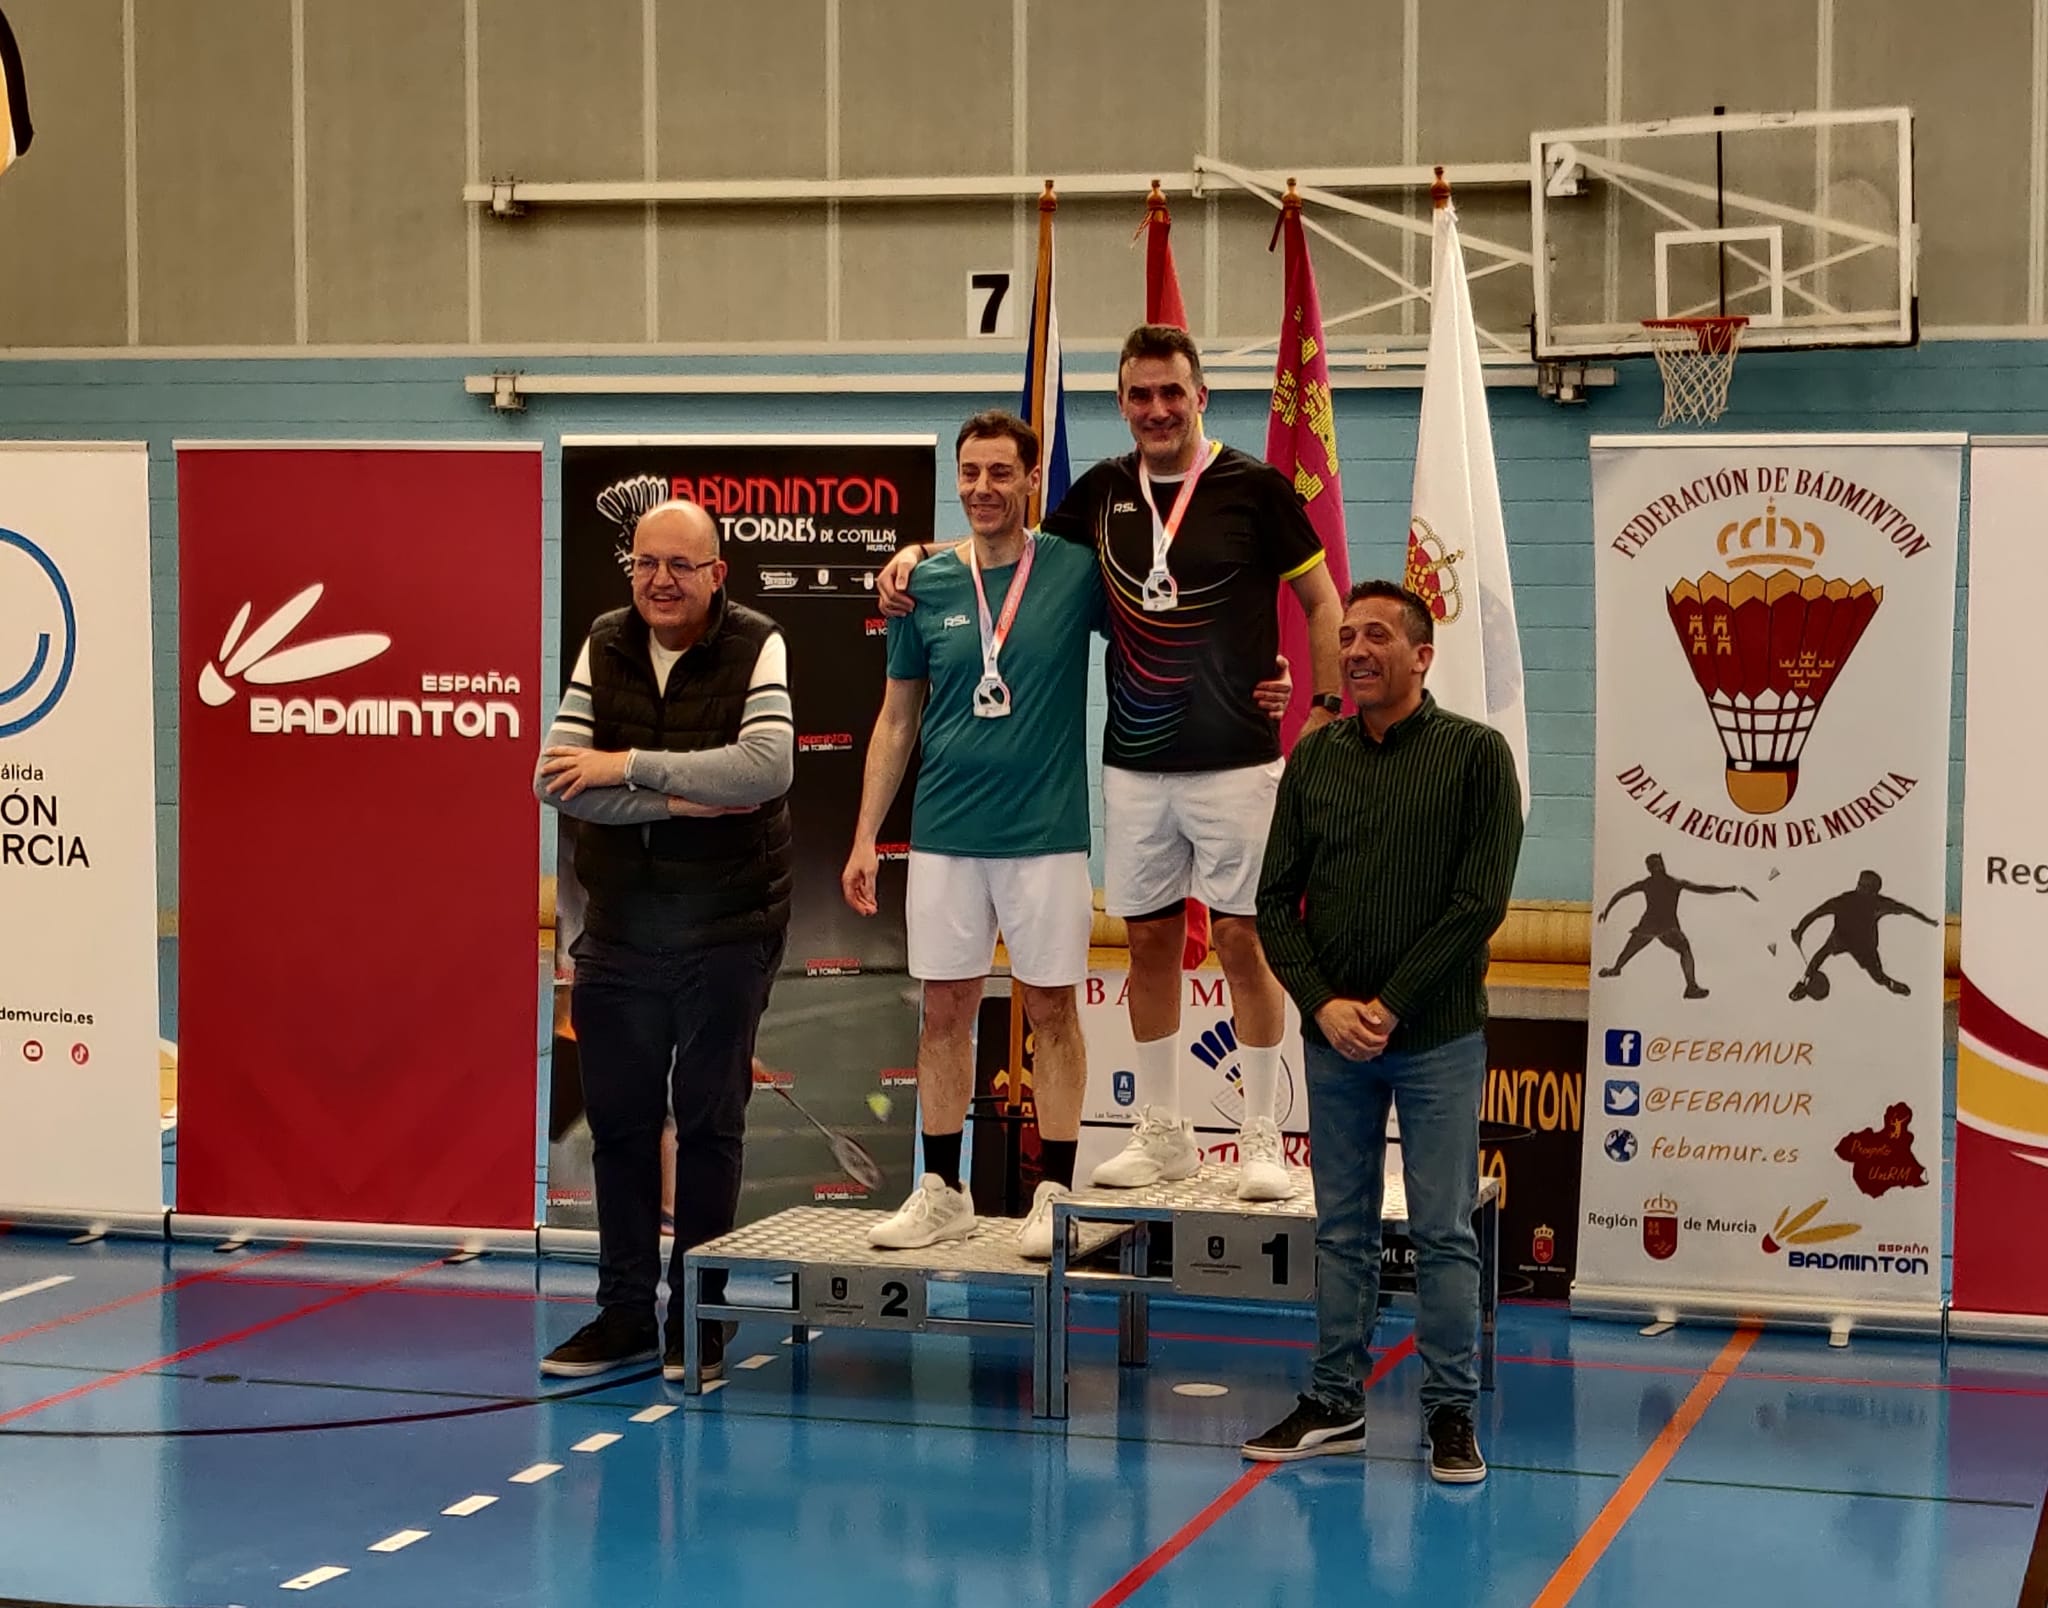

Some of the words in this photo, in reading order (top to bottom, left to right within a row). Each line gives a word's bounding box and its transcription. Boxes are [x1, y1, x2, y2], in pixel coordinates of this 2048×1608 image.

[1546, 142, 1579, 197] 2
[972, 274, 1010, 334] 7
[1113, 502, 1137, 514] RSL
[1611, 468, 1749, 559] FEDERACIÓN
[1757, 467, 1789, 493] DE
[1795, 468, 1932, 559] BÁDMINTON
[720, 517, 816, 543] TORRES
[820, 529, 834, 543] DE
[837, 529, 897, 544] COTILLAS
[866, 543, 896, 552] MURCIA
[944, 614, 970, 629] RSL
[421, 671, 521, 694] ESPAÑA
[250, 697, 520, 738] BADMINTON
[1616, 764, 1657, 800] DE
[1644, 789, 1682, 825] LA
[1680, 807, 1778, 849] REGIÓN
[1785, 818, 1822, 848] DE
[1820, 771, 1919, 840] MURCIA
[1646, 1037, 1814, 1065] @FEBAMUR
[1645, 1087, 1813, 1116] @FEBAMUR
[1651, 1136, 1799, 1164] febamur.es
[1588, 1212, 1638, 1229] Región
[1683, 1218, 1702, 1231] de
[1706, 1219, 1757, 1234] Murcia
[1262, 1233, 1289, 1285] 1
[1788, 1251, 1929, 1275] BADMINTON
[1878, 1243, 1929, 1255] ESPAÑA
[880, 1281, 909, 1317] 2
